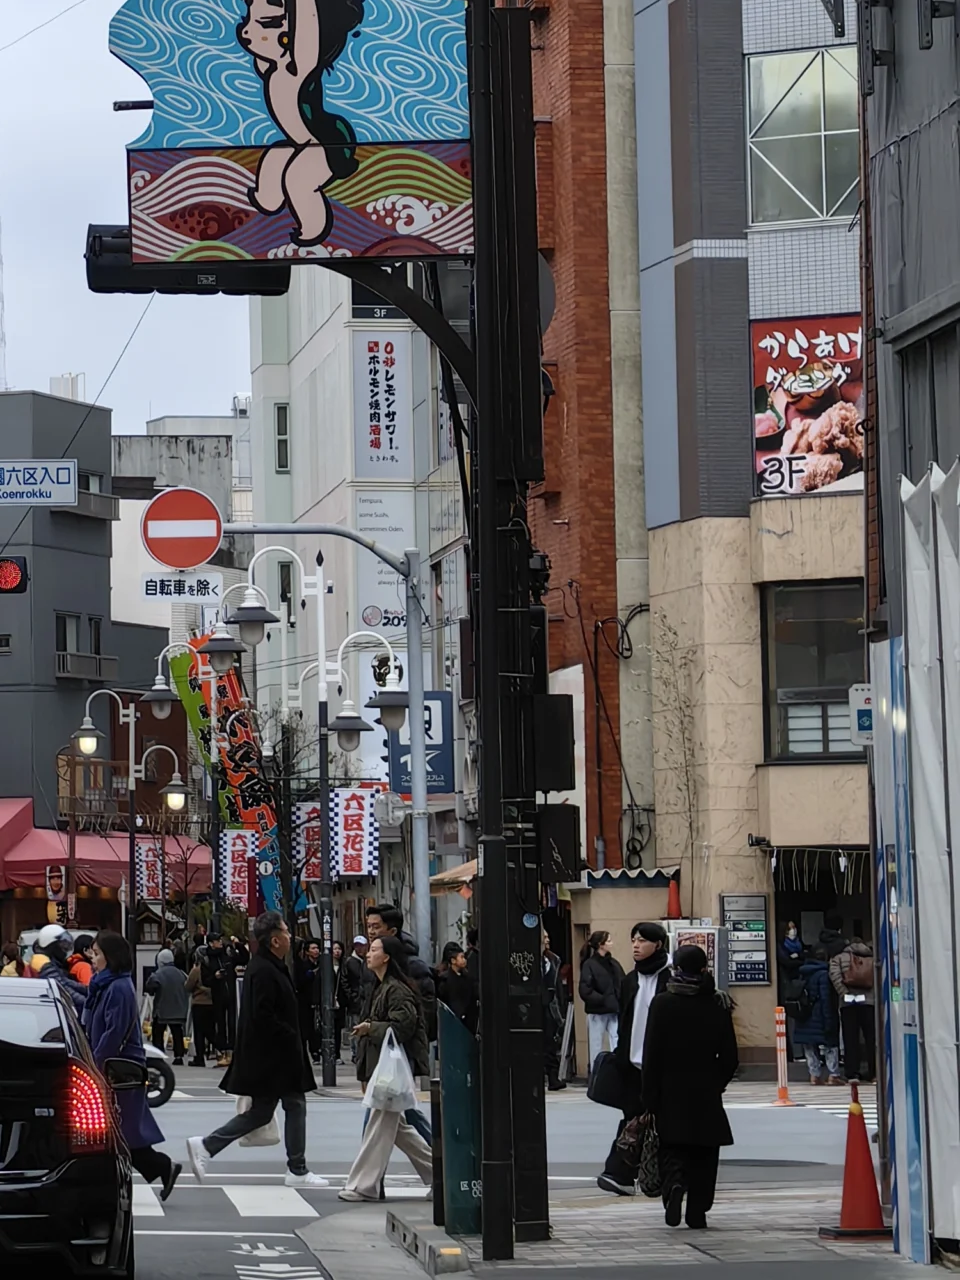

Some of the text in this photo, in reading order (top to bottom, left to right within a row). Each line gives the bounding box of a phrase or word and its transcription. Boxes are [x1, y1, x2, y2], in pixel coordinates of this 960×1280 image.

[373, 308, 388, 318] 3F
[765, 361, 852, 394] ダイニング
[368, 354, 382, 450] ホルモン焼肉酒場
[762, 454, 808, 491] 3F
[144, 578, 219, 597] 自転車を除く
[342, 792, 366, 873] 六区花道
[144, 847, 161, 900] 六区花道
[230, 832, 249, 895] 六区花道
